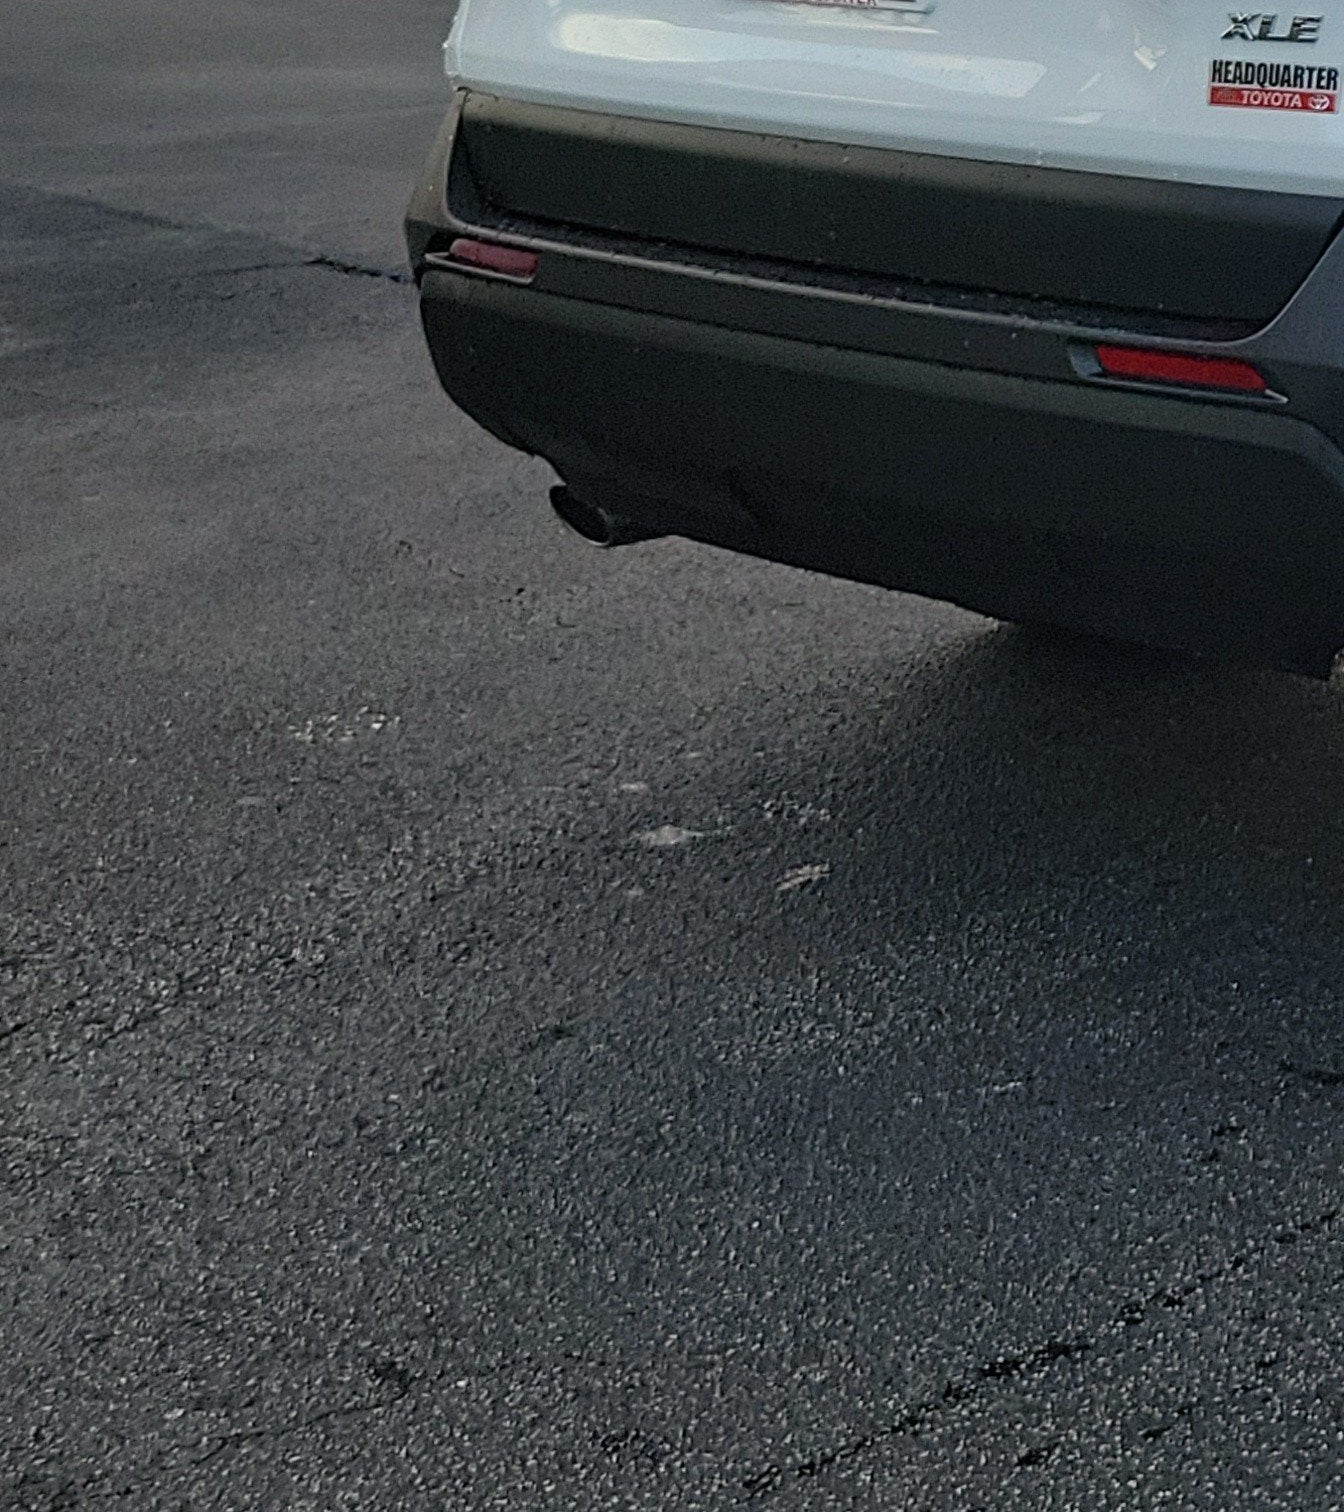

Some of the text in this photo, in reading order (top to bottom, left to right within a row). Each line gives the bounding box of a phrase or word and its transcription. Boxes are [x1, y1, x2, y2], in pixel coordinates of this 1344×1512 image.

[1220, 11, 1324, 43] XLE
[1211, 59, 1339, 91] HEADQUARTER
[1240, 90, 1303, 108] TOYOTA
